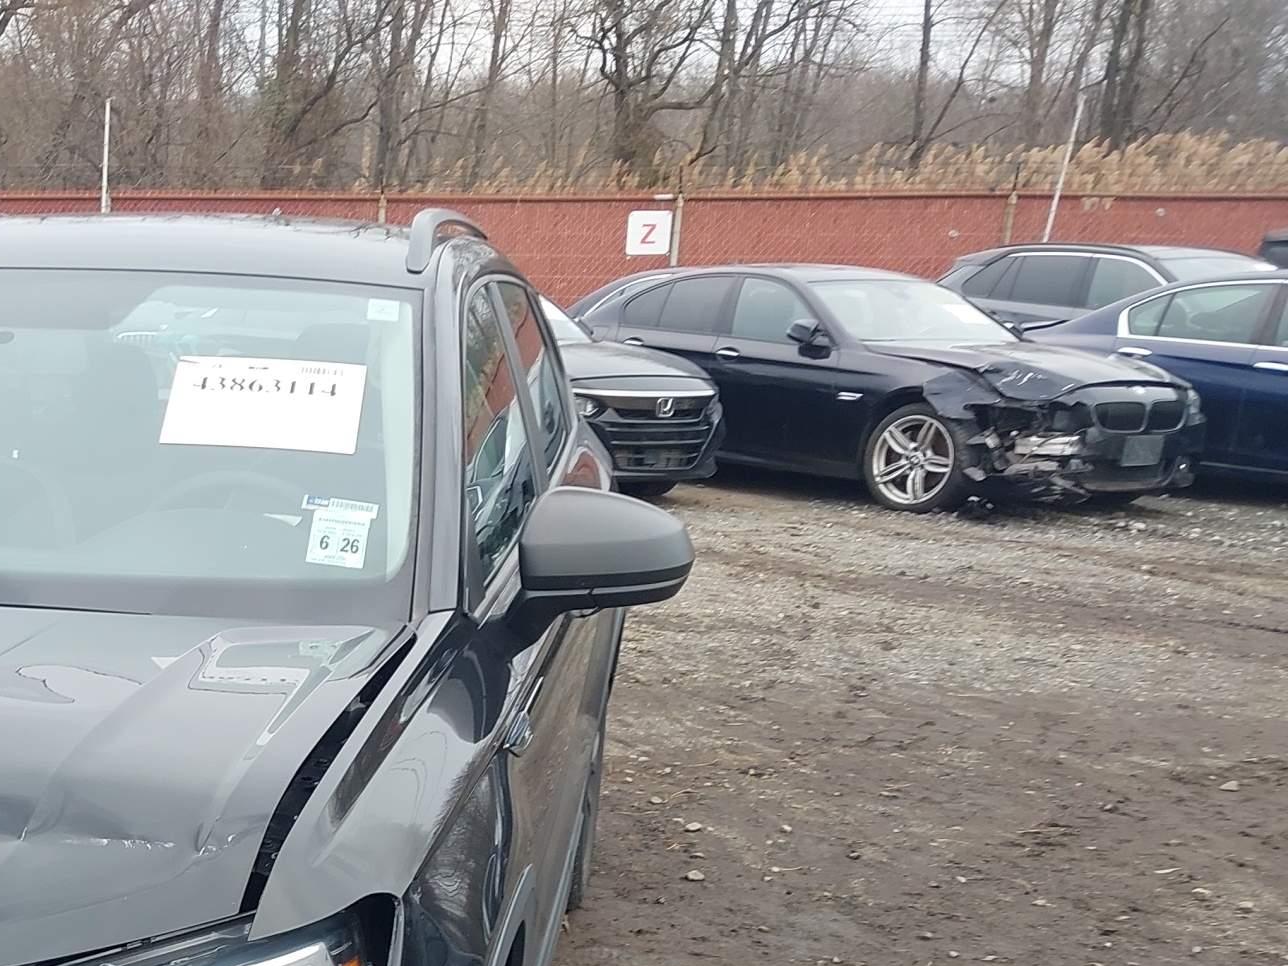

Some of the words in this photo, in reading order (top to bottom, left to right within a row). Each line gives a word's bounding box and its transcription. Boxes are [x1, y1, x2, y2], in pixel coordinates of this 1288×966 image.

[639, 223, 658, 245] Z
[192, 375, 338, 398] 43863114
[319, 534, 331, 551] 6
[339, 537, 361, 555] 26
